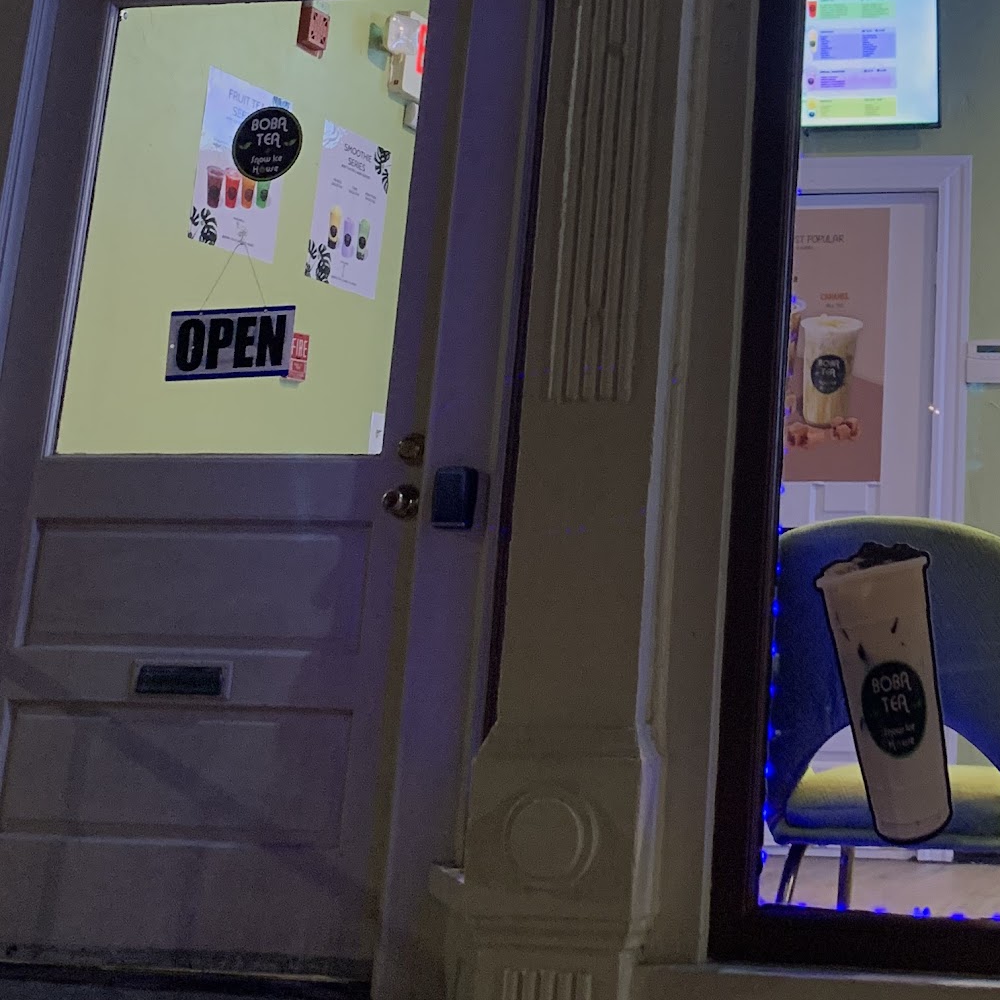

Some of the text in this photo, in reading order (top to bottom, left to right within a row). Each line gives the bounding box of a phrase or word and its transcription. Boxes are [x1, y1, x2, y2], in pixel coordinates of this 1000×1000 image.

[250, 116, 289, 133] BOBA
[256, 132, 282, 149] TEA
[343, 143, 373, 164] SMOOTHIE
[175, 314, 287, 372] OPEN
[291, 337, 308, 358] FIRE
[871, 671, 912, 694] BOBA
[881, 693, 911, 714] TEA
